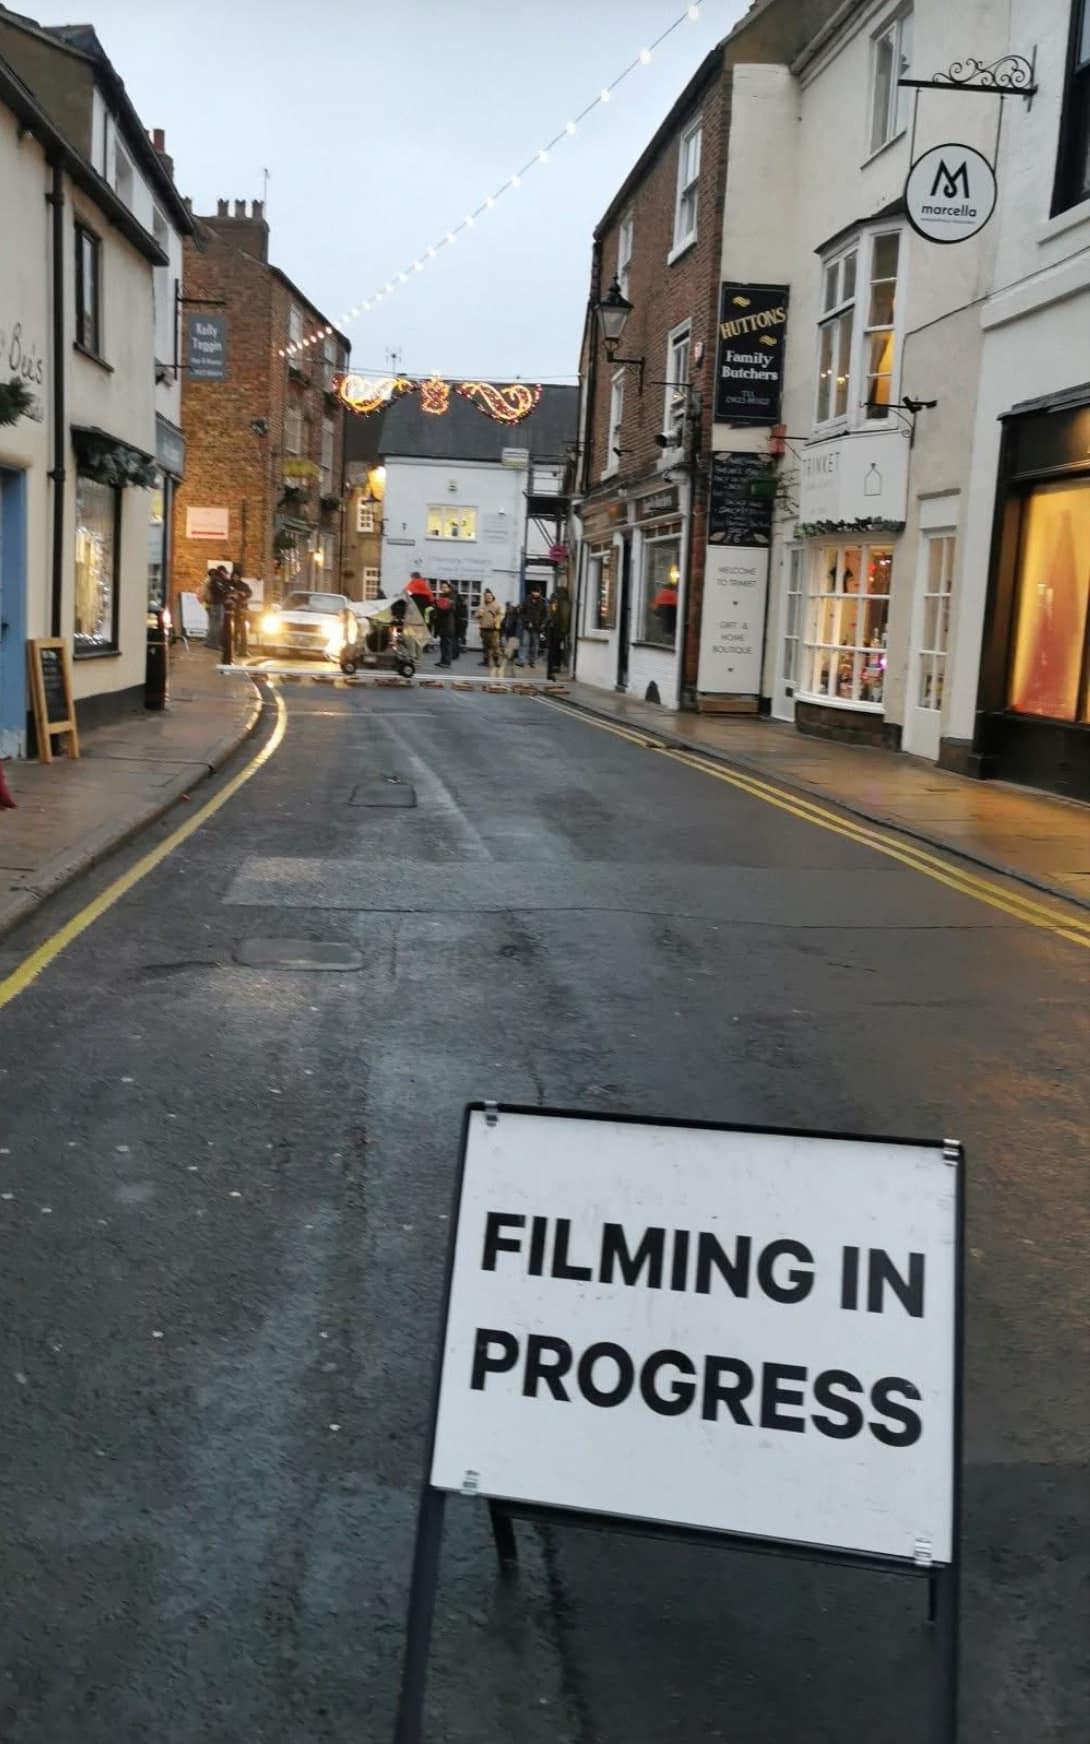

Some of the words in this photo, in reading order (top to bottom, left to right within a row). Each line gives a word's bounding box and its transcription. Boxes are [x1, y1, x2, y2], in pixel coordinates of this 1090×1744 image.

[921, 204, 977, 217] marcella
[720, 307, 786, 339] HUTTONS
[721, 366, 779, 381] Butchers
[725, 350, 774, 369] Family
[801, 451, 841, 480] TRINKET
[481, 1211, 815, 1305] FILMING
[841, 1245, 925, 1319] IN
[470, 1327, 923, 1448] PROGRESS
